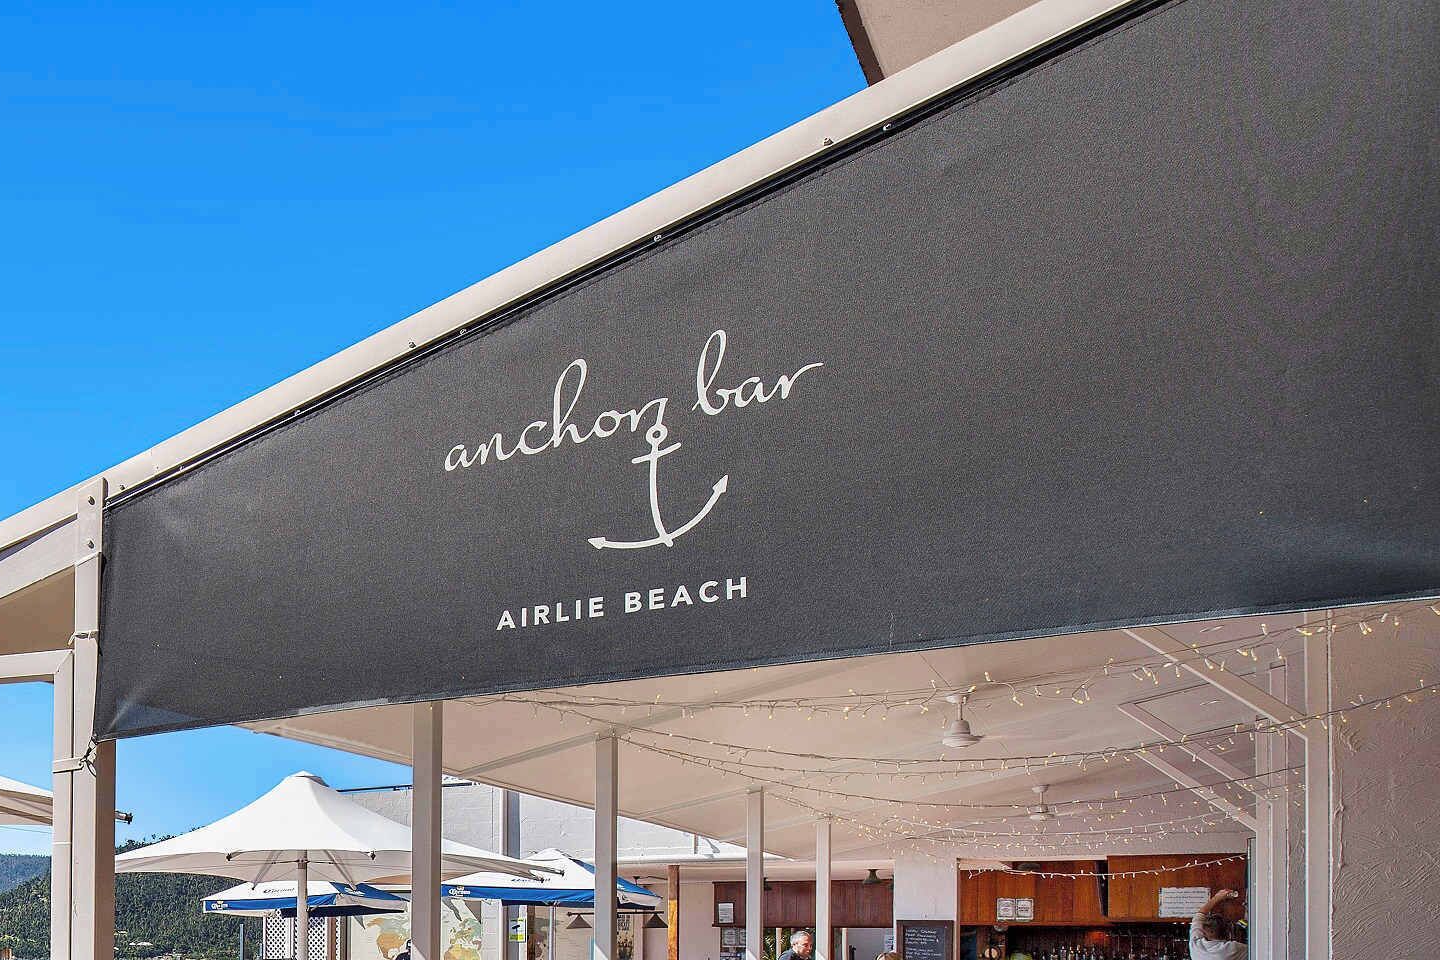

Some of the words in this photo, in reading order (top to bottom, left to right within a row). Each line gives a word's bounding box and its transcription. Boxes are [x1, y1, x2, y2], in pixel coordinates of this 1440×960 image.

[444, 358, 669, 472] anchor
[691, 329, 824, 416] bar
[495, 596, 604, 631] AIRLIE
[624, 576, 747, 614] BEACH
